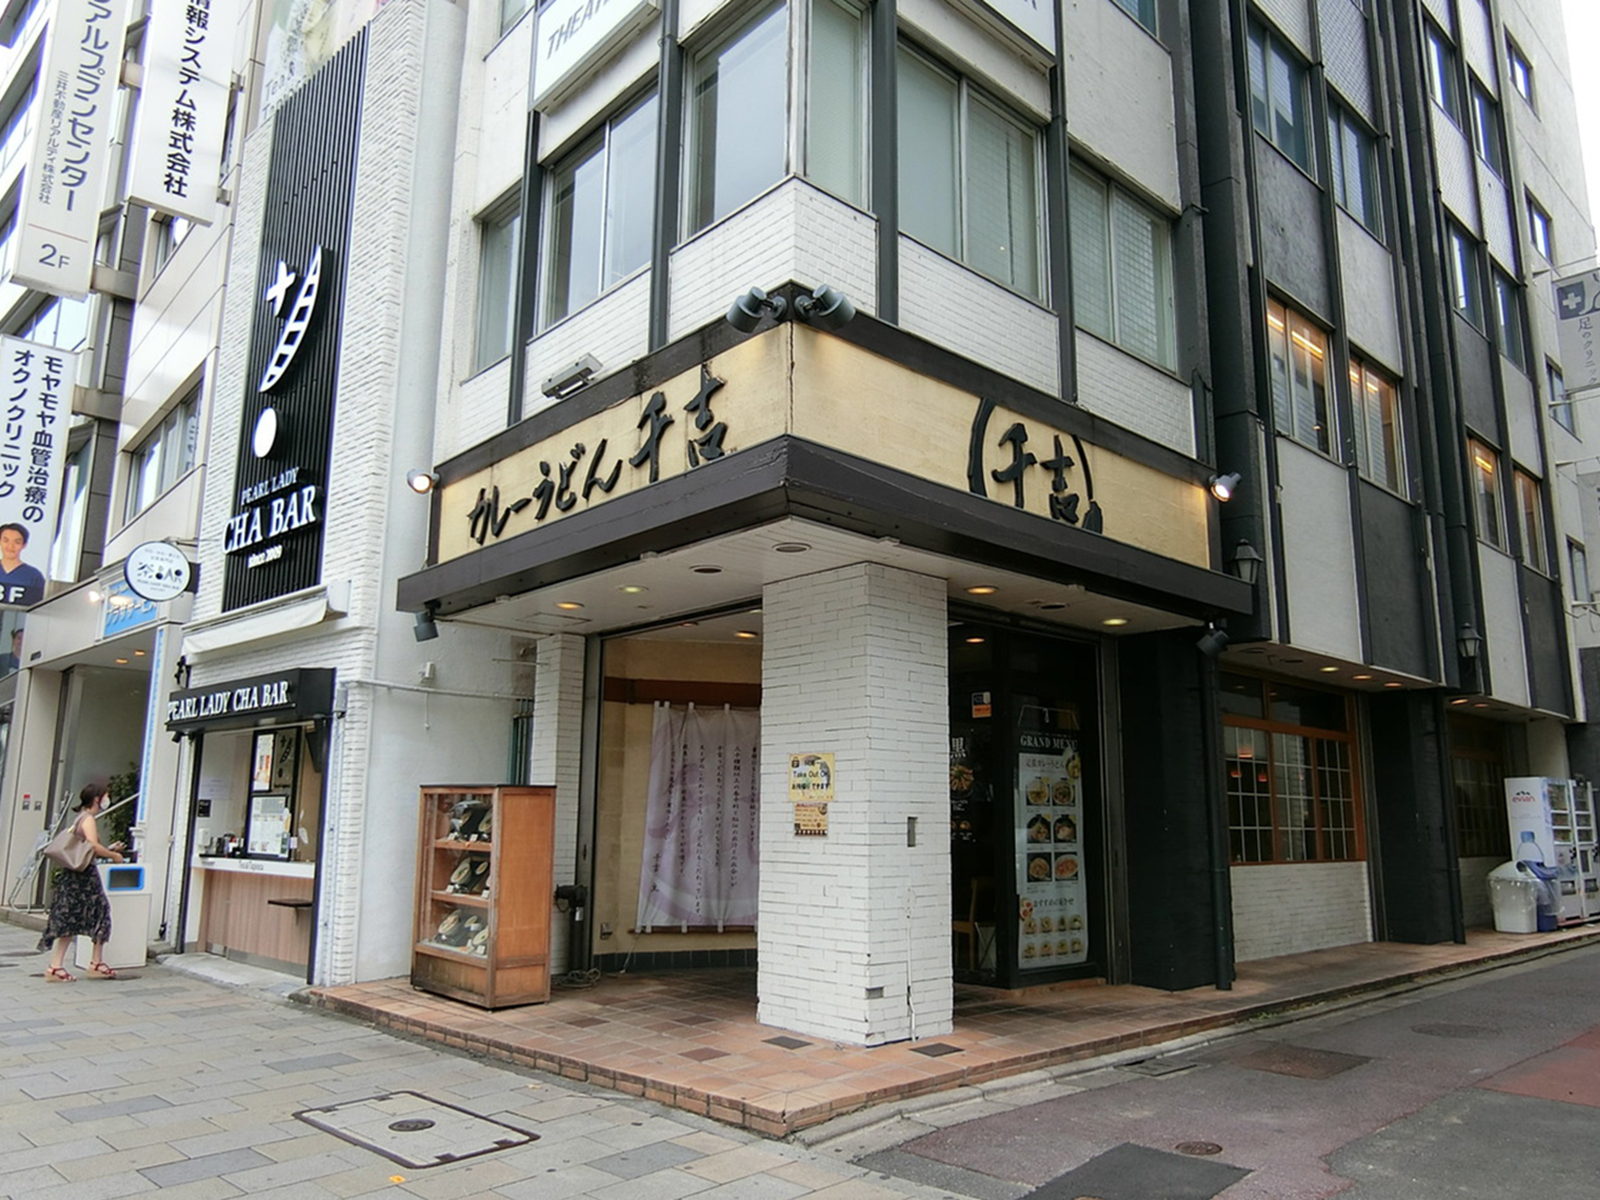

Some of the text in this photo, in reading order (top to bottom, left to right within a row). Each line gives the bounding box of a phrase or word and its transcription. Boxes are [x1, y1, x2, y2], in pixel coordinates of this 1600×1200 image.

[61, 0, 112, 212] アルプランセンター
[38, 243, 71, 270] 2F
[0, 350, 35, 498] オクノクリニック
[22, 355, 64, 524] モヤモヤ血管治療の
[222, 485, 316, 554] CHA BAR
[241, 466, 299, 506] PEARL LADY
[467, 438, 623, 546] カレーうどん
[167, 680, 289, 721] PEARL LADY CHA BAR
[1020, 735, 1051, 748] GRAND
